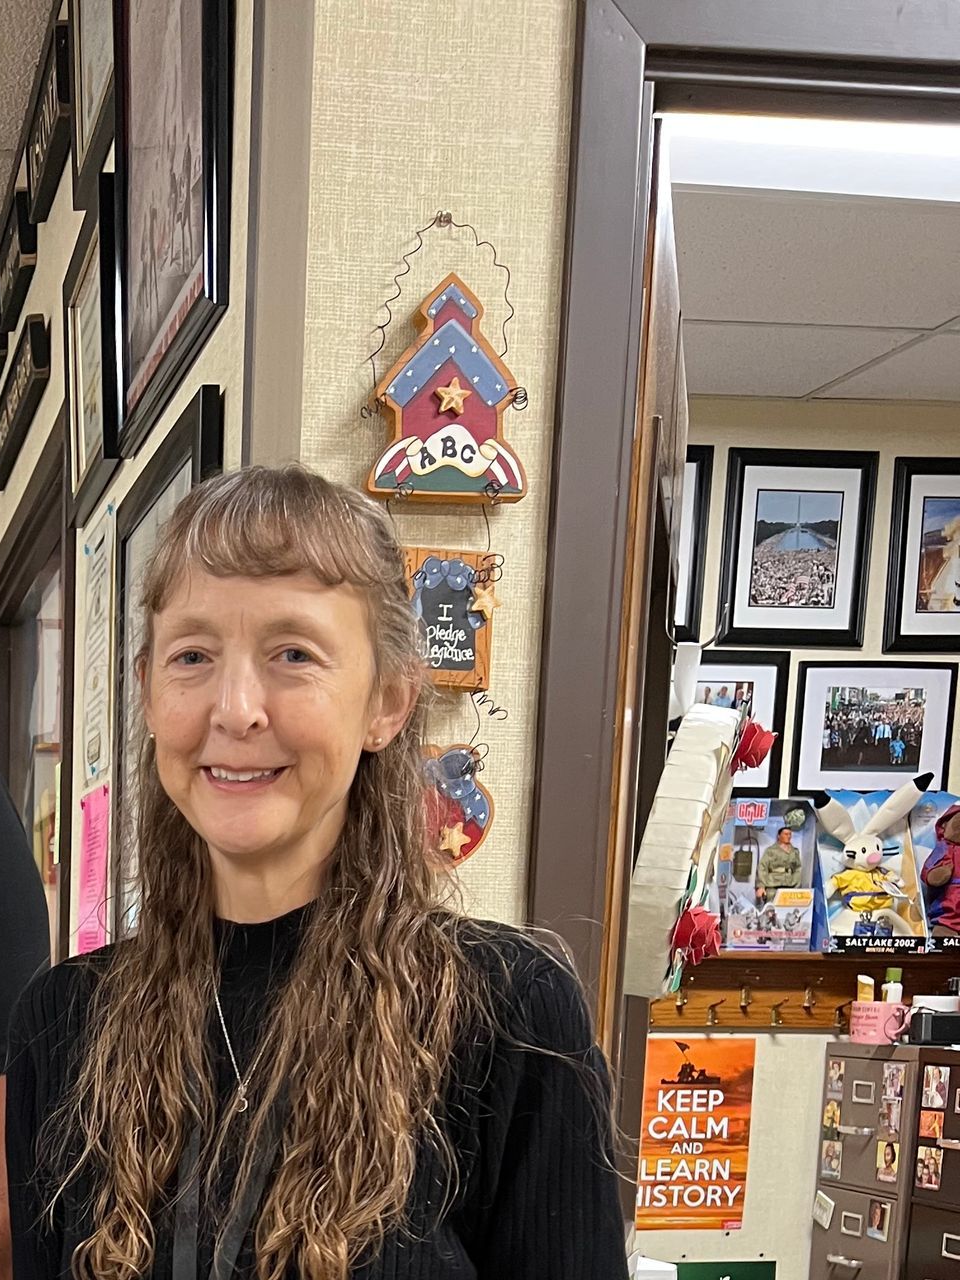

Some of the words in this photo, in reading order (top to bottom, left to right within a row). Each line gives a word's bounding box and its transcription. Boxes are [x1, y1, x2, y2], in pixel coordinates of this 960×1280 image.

[845, 938, 867, 947] SALT
[868, 938, 893, 947] LAKE
[894, 939, 916, 948] 2002
[657, 1089, 725, 1112] KEEP
[647, 1116, 729, 1140] CALM
[671, 1142, 704, 1155] AND
[640, 1158, 731, 1181] LEARN
